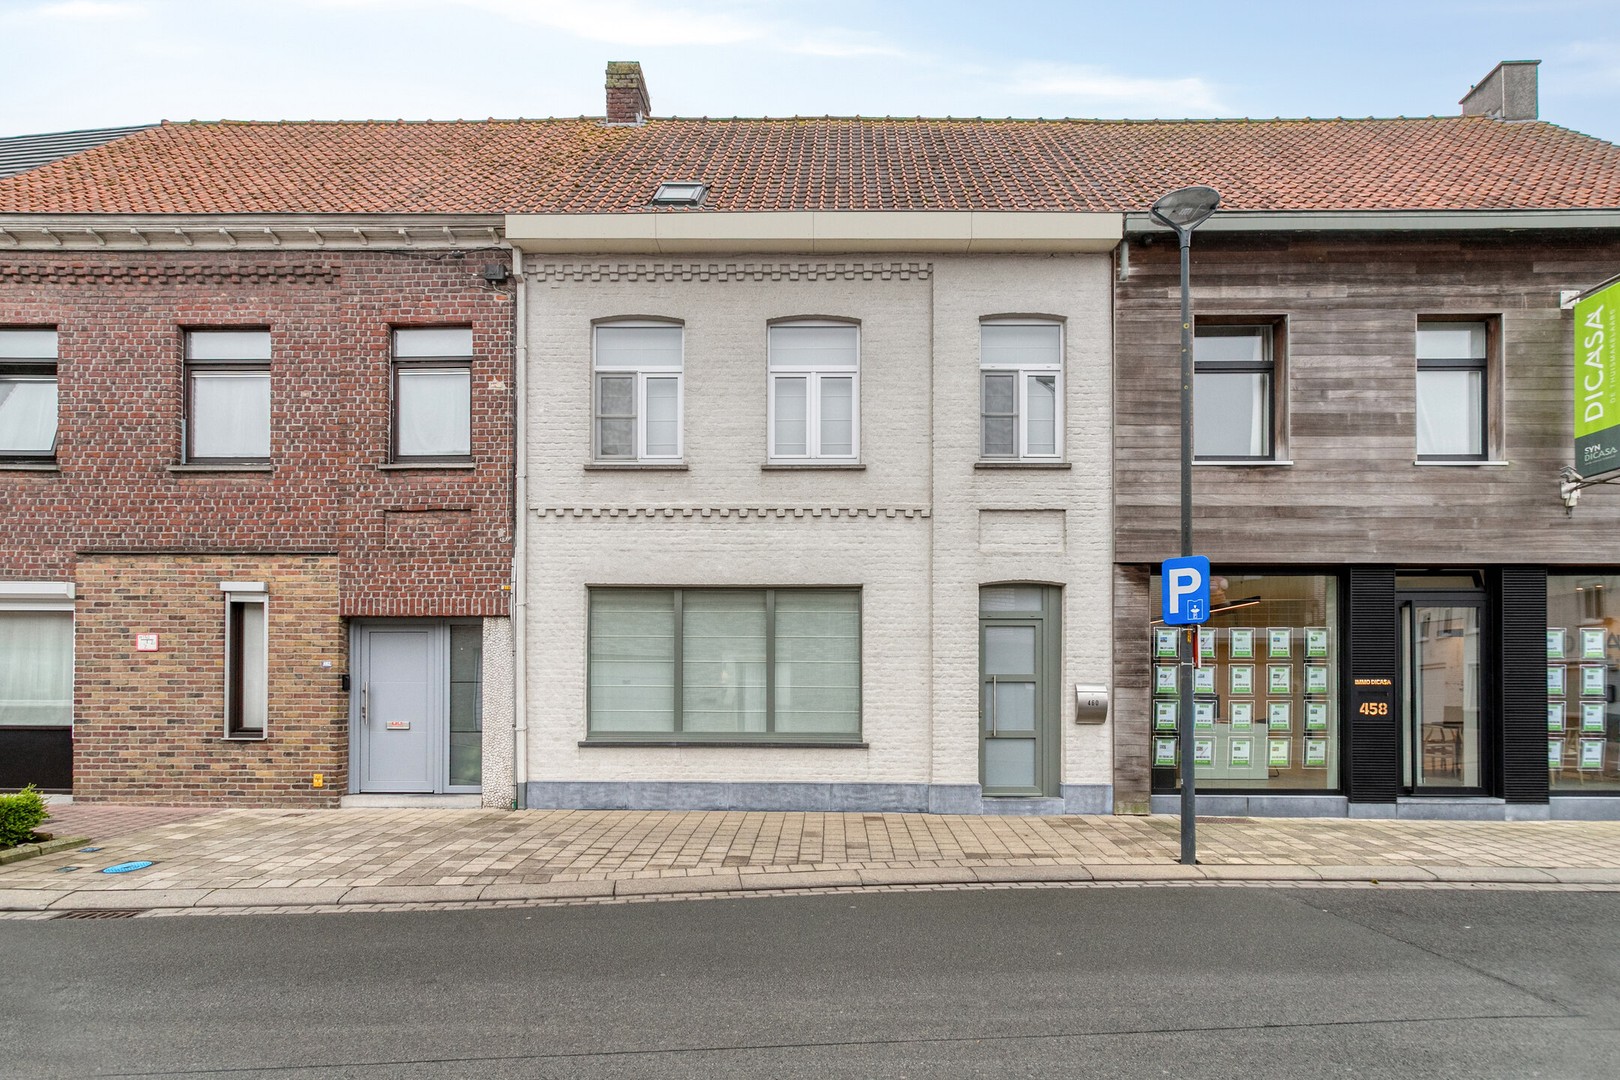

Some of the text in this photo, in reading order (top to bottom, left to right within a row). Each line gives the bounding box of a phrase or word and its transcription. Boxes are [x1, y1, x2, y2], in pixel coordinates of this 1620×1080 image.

[1584, 304, 1604, 422] DICASA
[1584, 443, 1601, 453] SYN
[1584, 446, 1618, 462] DICASA
[1169, 567, 1202, 614] P
[1359, 702, 1388, 715] 458
